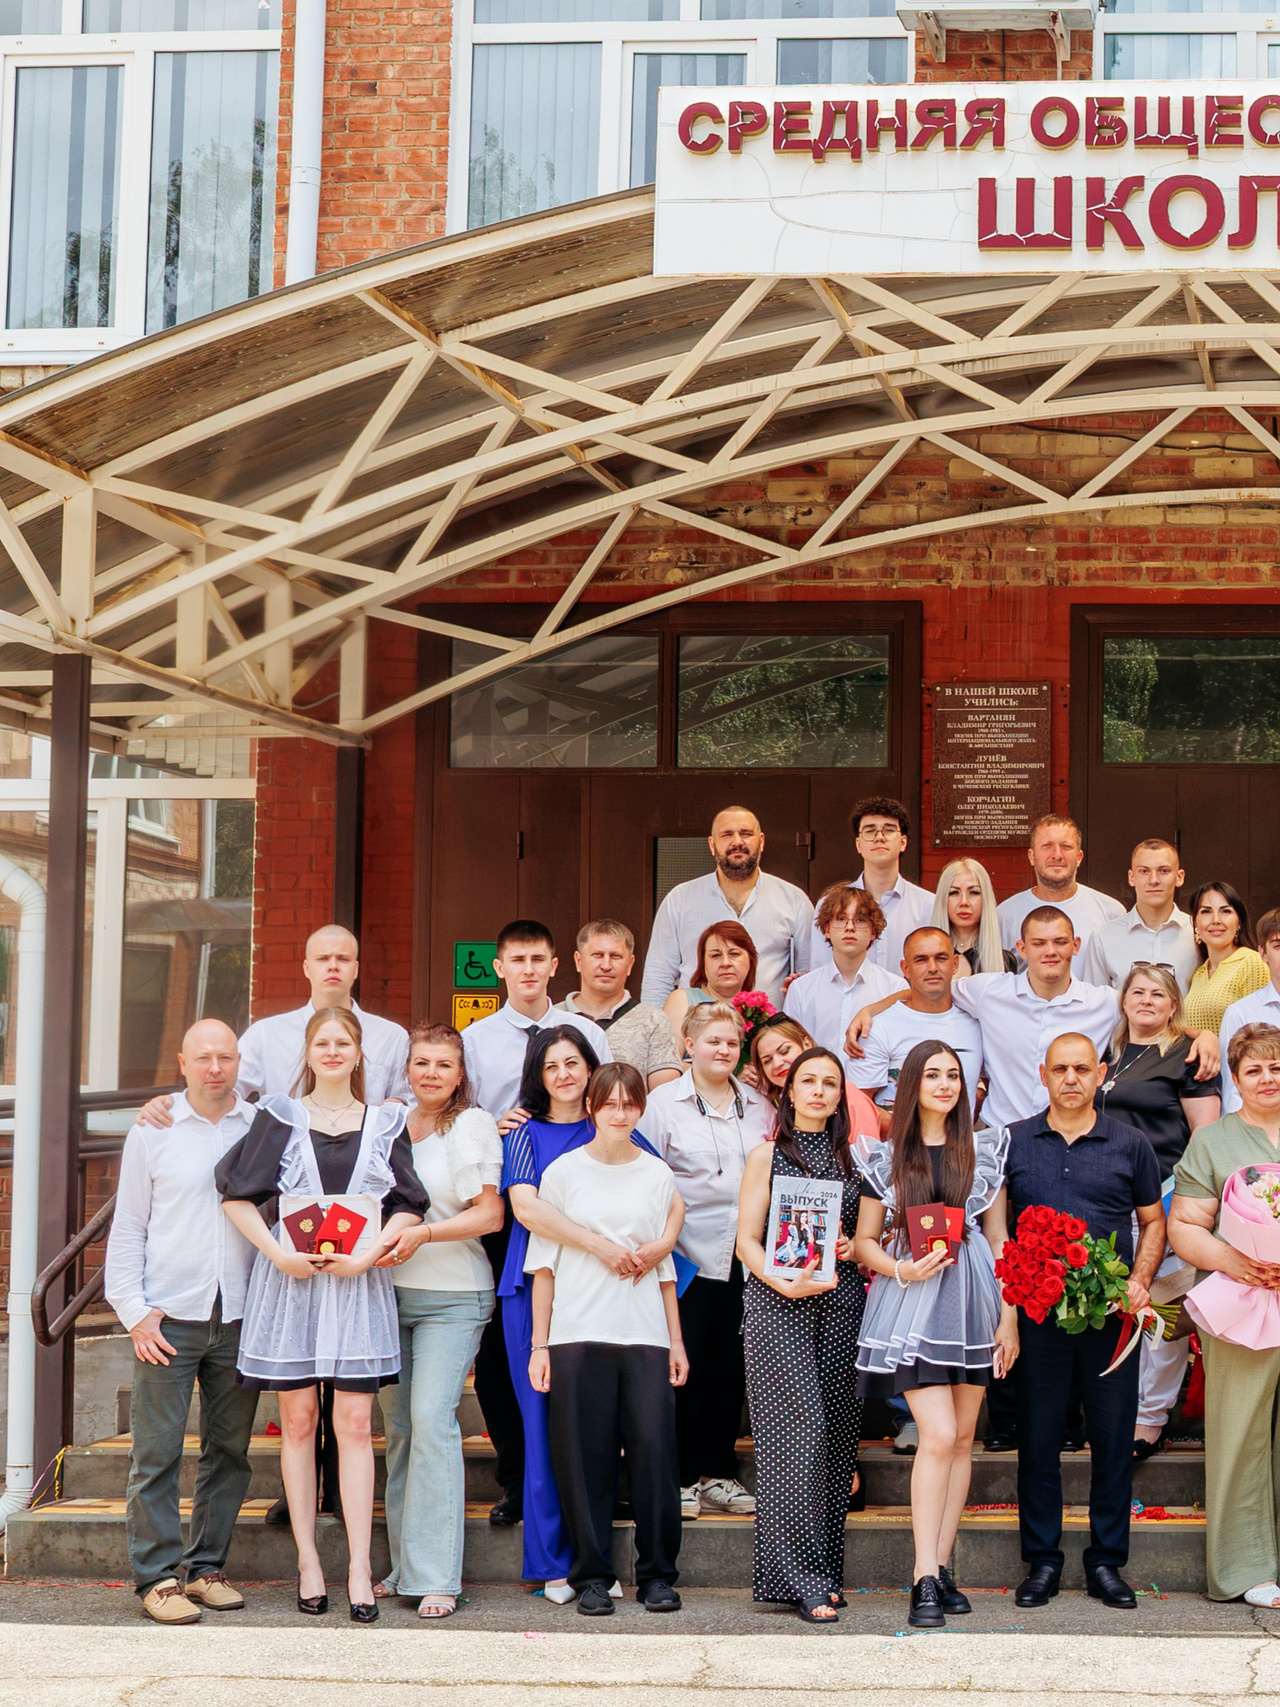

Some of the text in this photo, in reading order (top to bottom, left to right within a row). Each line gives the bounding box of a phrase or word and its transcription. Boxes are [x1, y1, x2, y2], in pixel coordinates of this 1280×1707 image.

[677, 97, 1006, 163] СРЕДНЯЯ
[945, 687, 1039, 696] В НАШЕЙ ШКОЛЕ
[964, 698, 1019, 706] УЧИЛИСЬ:
[975, 754, 1007, 762] ЛУНЁВ
[820, 1191, 838, 1199] 2026
[780, 1193, 829, 1208] ВЫПУСК
